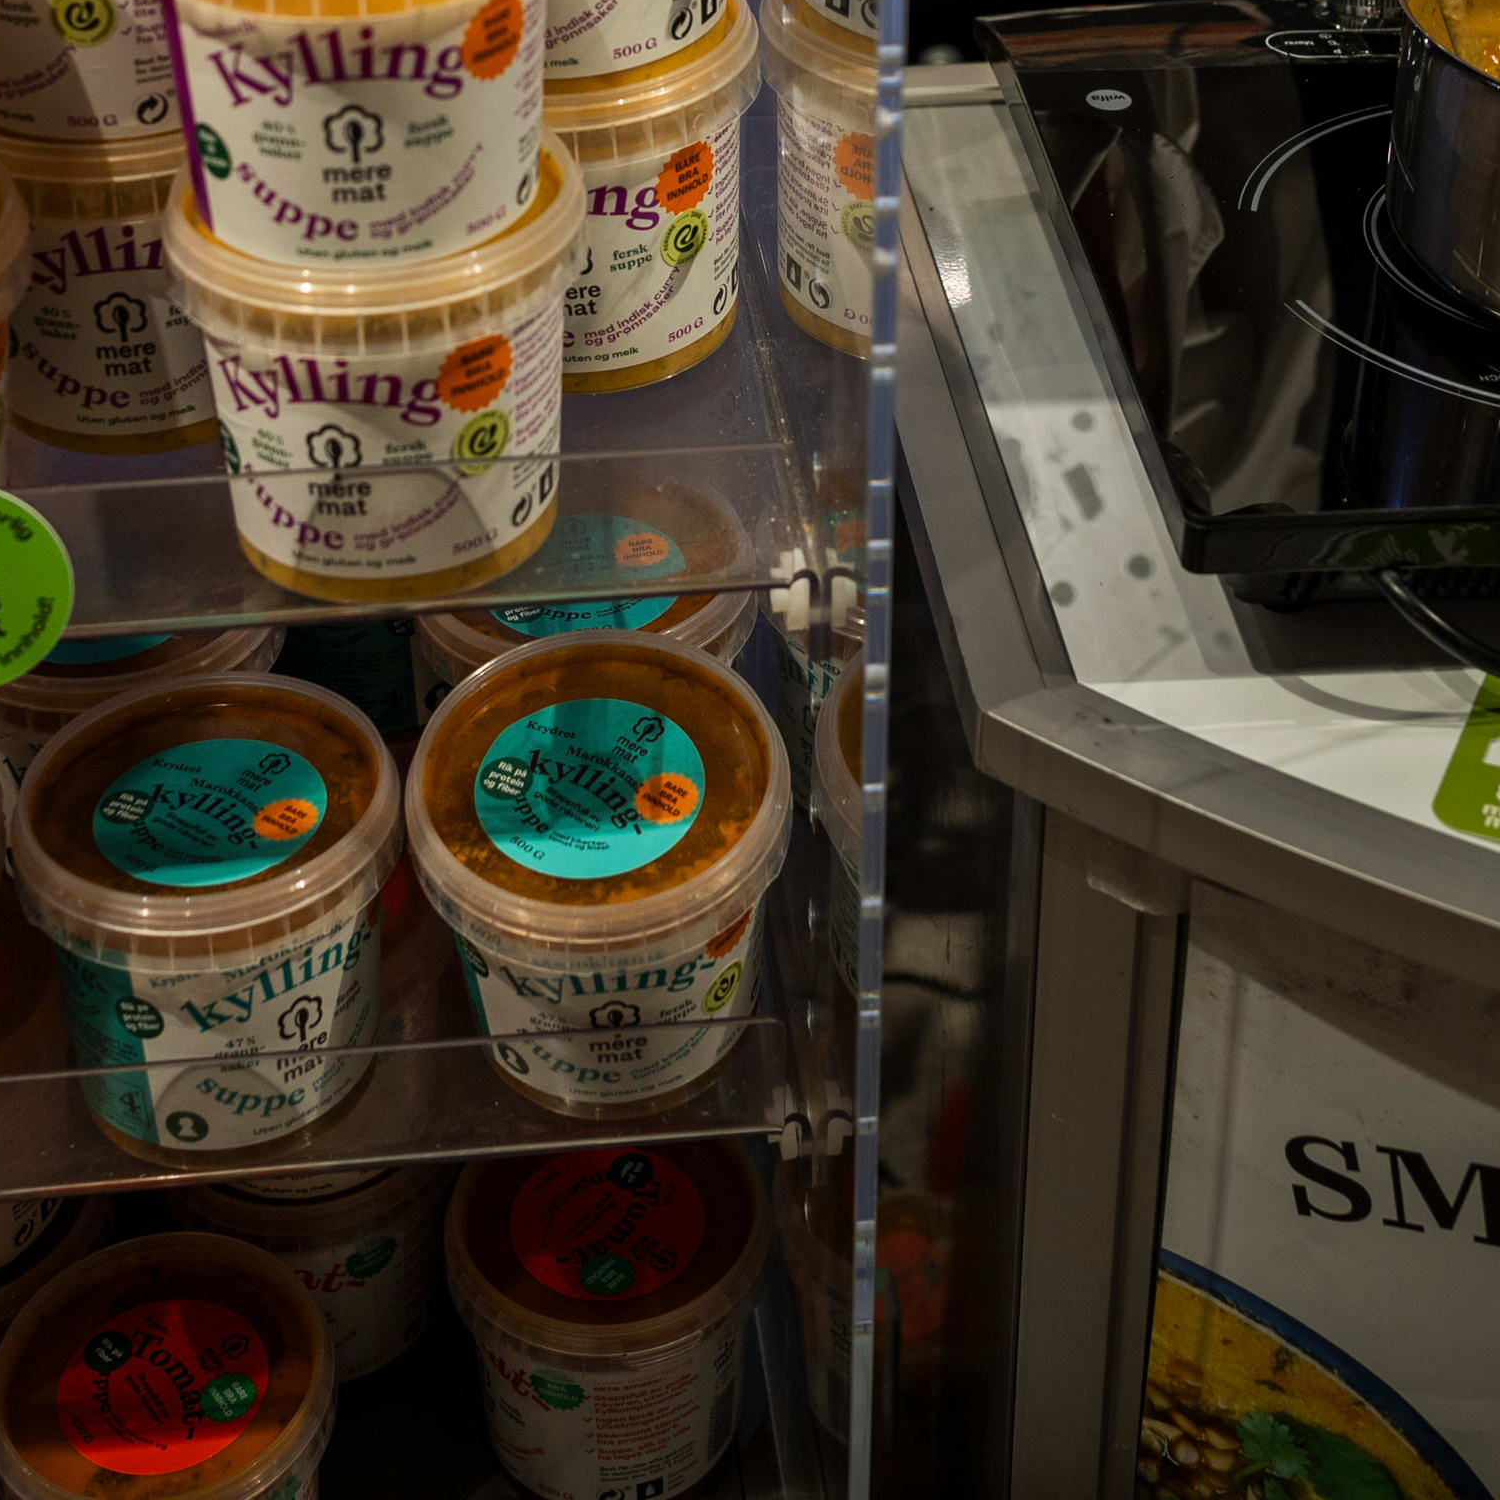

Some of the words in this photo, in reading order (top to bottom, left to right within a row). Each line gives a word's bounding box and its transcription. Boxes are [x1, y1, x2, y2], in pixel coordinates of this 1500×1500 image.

[611, 39, 642, 61] 500
[643, 35, 659, 52] G
[208, 26, 466, 108] Kylling
[675, 151, 701, 173] BARE
[322, 162, 393, 185] mere
[677, 167, 699, 184] BRA
[331, 183, 386, 205] mat
[666, 172, 709, 202] INNHOLD
[235, 161, 360, 244] suppe
[30, 225, 164, 296] ylli
[609, 253, 654, 274] suppe
[611, 244, 649, 262] fersk
[583, 326, 606, 340] med
[606, 300, 654, 332] indisk
[653, 265, 682, 306] curry
[584, 334, 604, 347] og
[605, 285, 675, 343] grønnsaker
[667, 324, 692, 344] 500
[693, 315, 705, 329] G
[95, 341, 157, 361] mere
[20, 341, 131, 410] suppe
[104, 357, 154, 377] mat
[218, 354, 443, 428] Kylling
[308, 481, 372, 500] mere
[243, 463, 346, 551] suppe
[318, 498, 369, 518] mat
[526, 719, 578, 741] Krydret
[611, 744, 639, 765] mat
[616, 734, 649, 758] mere
[242, 768, 273, 787] mere
[487, 769, 525, 789] protein
[497, 760, 514, 773] Rik
[513, 767, 529, 779] på
[235, 776, 262, 794] mat
[483, 777, 499, 791] og
[498, 781, 522, 797] fiber
[528, 748, 644, 836] kylling-
[663, 780, 689, 799] BARE
[641, 791, 682, 818] INNHOLD
[659, 788, 679, 805] BRA
[151, 782, 260, 851] kylling-
[278, 812, 297, 824] BRA
[284, 804, 308, 819] BARE
[261, 814, 299, 835] INNHOLD
[180, 922, 372, 1034] kylling-
[499, 953, 717, 1006] kylling-
[589, 1035, 649, 1054] mere
[596, 1050, 644, 1064] mat
[195, 1077, 307, 1118] suppe
[130, 1328, 203, 1440] Tomat-
[229, 1379, 251, 1402] BARE
[207, 1385, 234, 1418] INNHOLD
[221, 1386, 238, 1407] BRA
